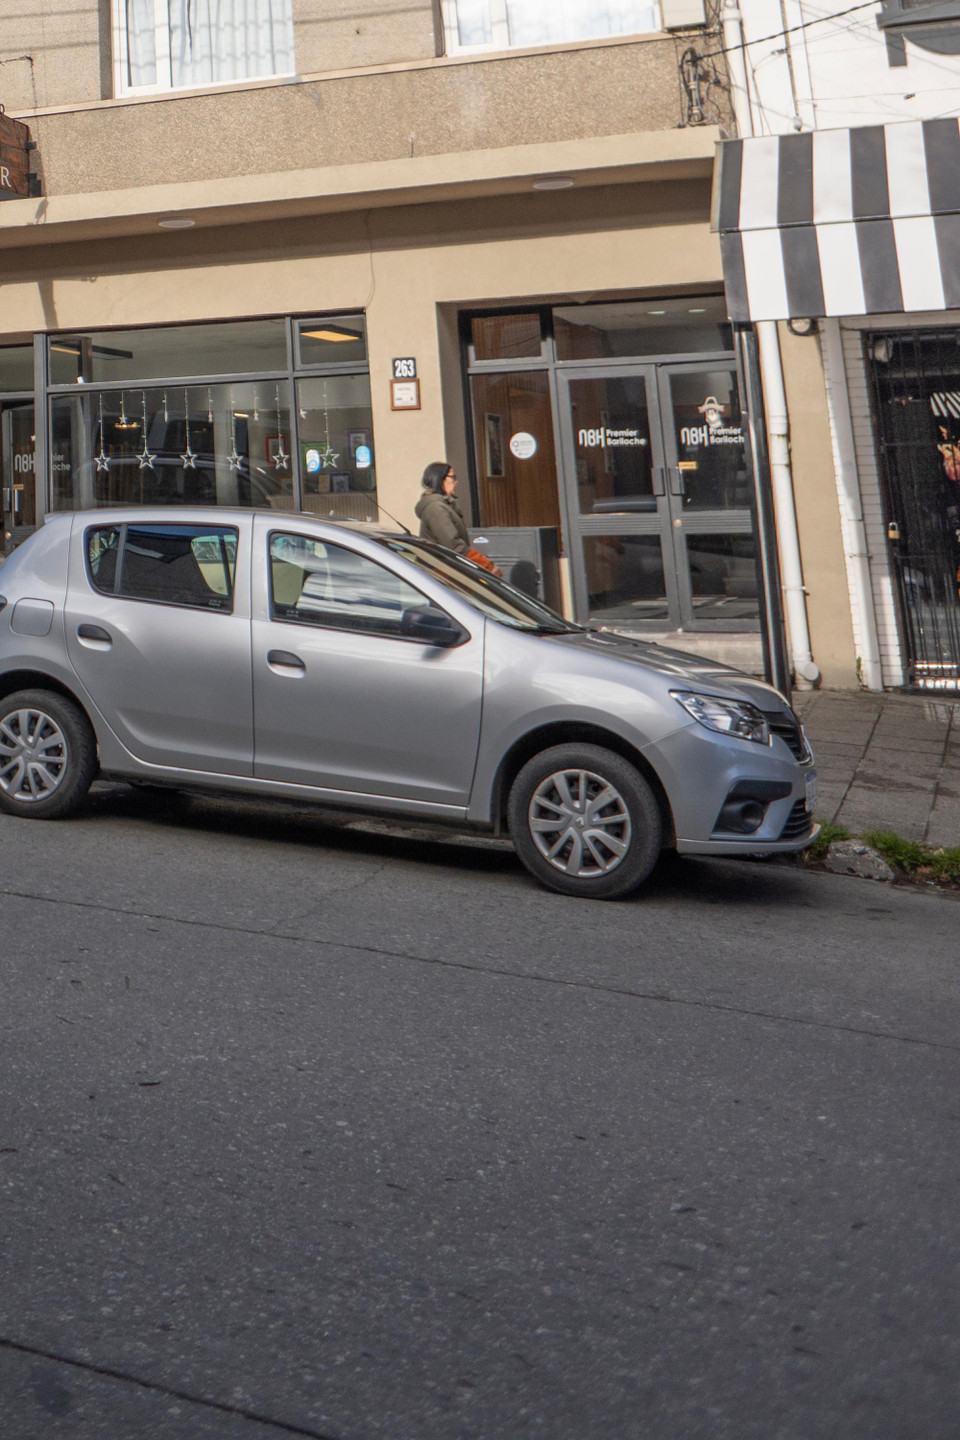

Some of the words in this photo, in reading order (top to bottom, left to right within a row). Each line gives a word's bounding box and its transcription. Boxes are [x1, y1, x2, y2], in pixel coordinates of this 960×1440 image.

[395, 359, 415, 377] 263
[606, 428, 637, 438] Premier
[606, 437, 646, 446] Bariloche
[709, 435, 745, 445] Bariloch
